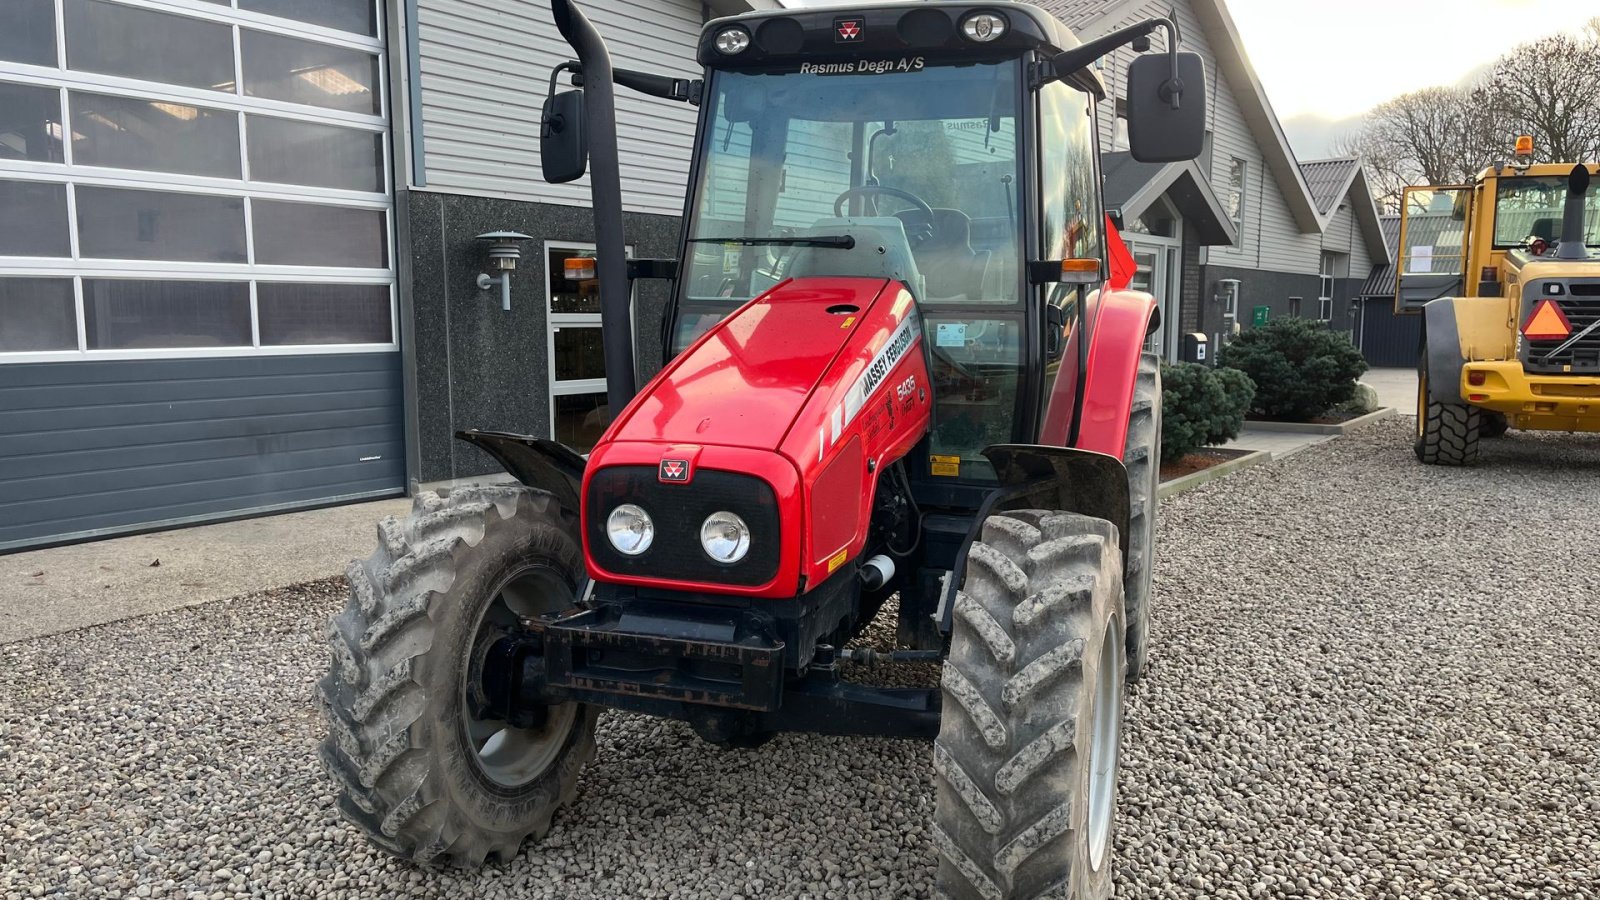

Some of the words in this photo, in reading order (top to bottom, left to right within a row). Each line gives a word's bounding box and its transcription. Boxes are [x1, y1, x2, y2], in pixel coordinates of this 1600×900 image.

[800, 62, 854, 74] Rasmus
[858, 59, 894, 73] Degn
[896, 56, 924, 72] A/S
[863, 354, 888, 397] MASSEY
[885, 325, 912, 367] FERGUSON
[896, 375, 916, 402] 5435
